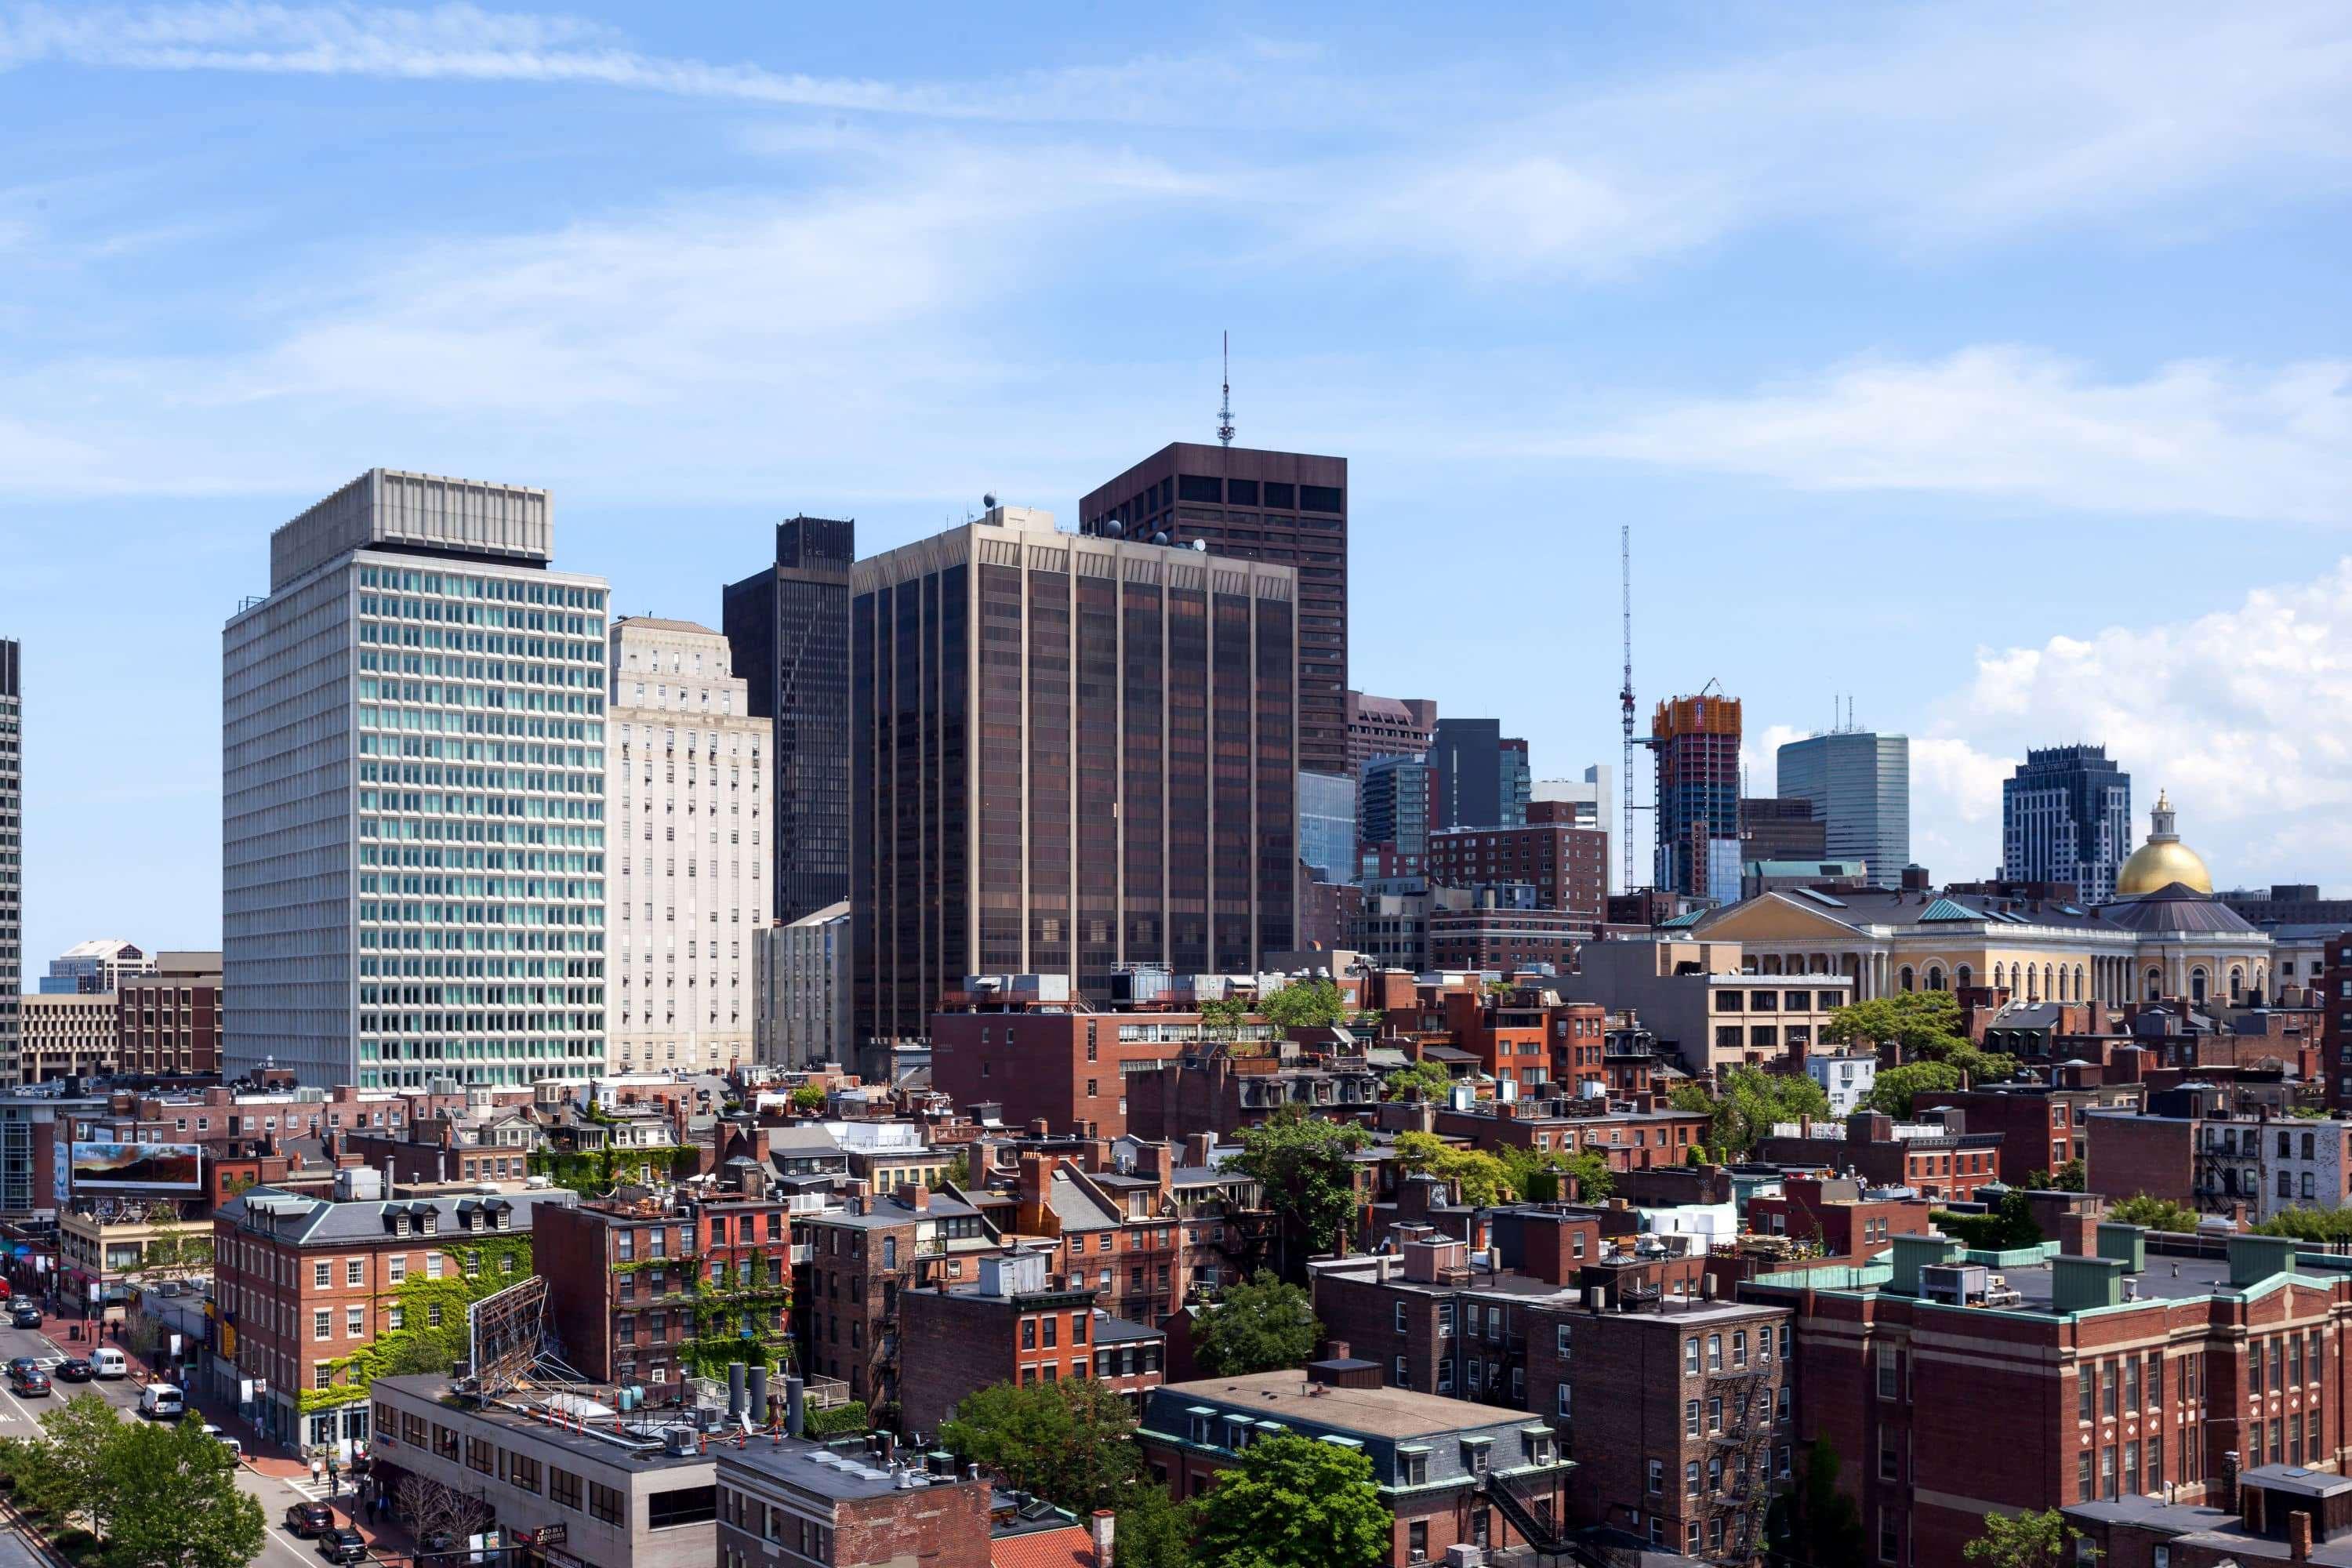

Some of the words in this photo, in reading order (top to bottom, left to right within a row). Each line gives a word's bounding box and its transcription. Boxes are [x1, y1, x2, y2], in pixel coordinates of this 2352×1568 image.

[2027, 764, 2045, 773] STATE
[2046, 761, 2068, 771] STREET
[539, 1526, 562, 1535] JOBI
[537, 1531, 565, 1541] LIQUORS
